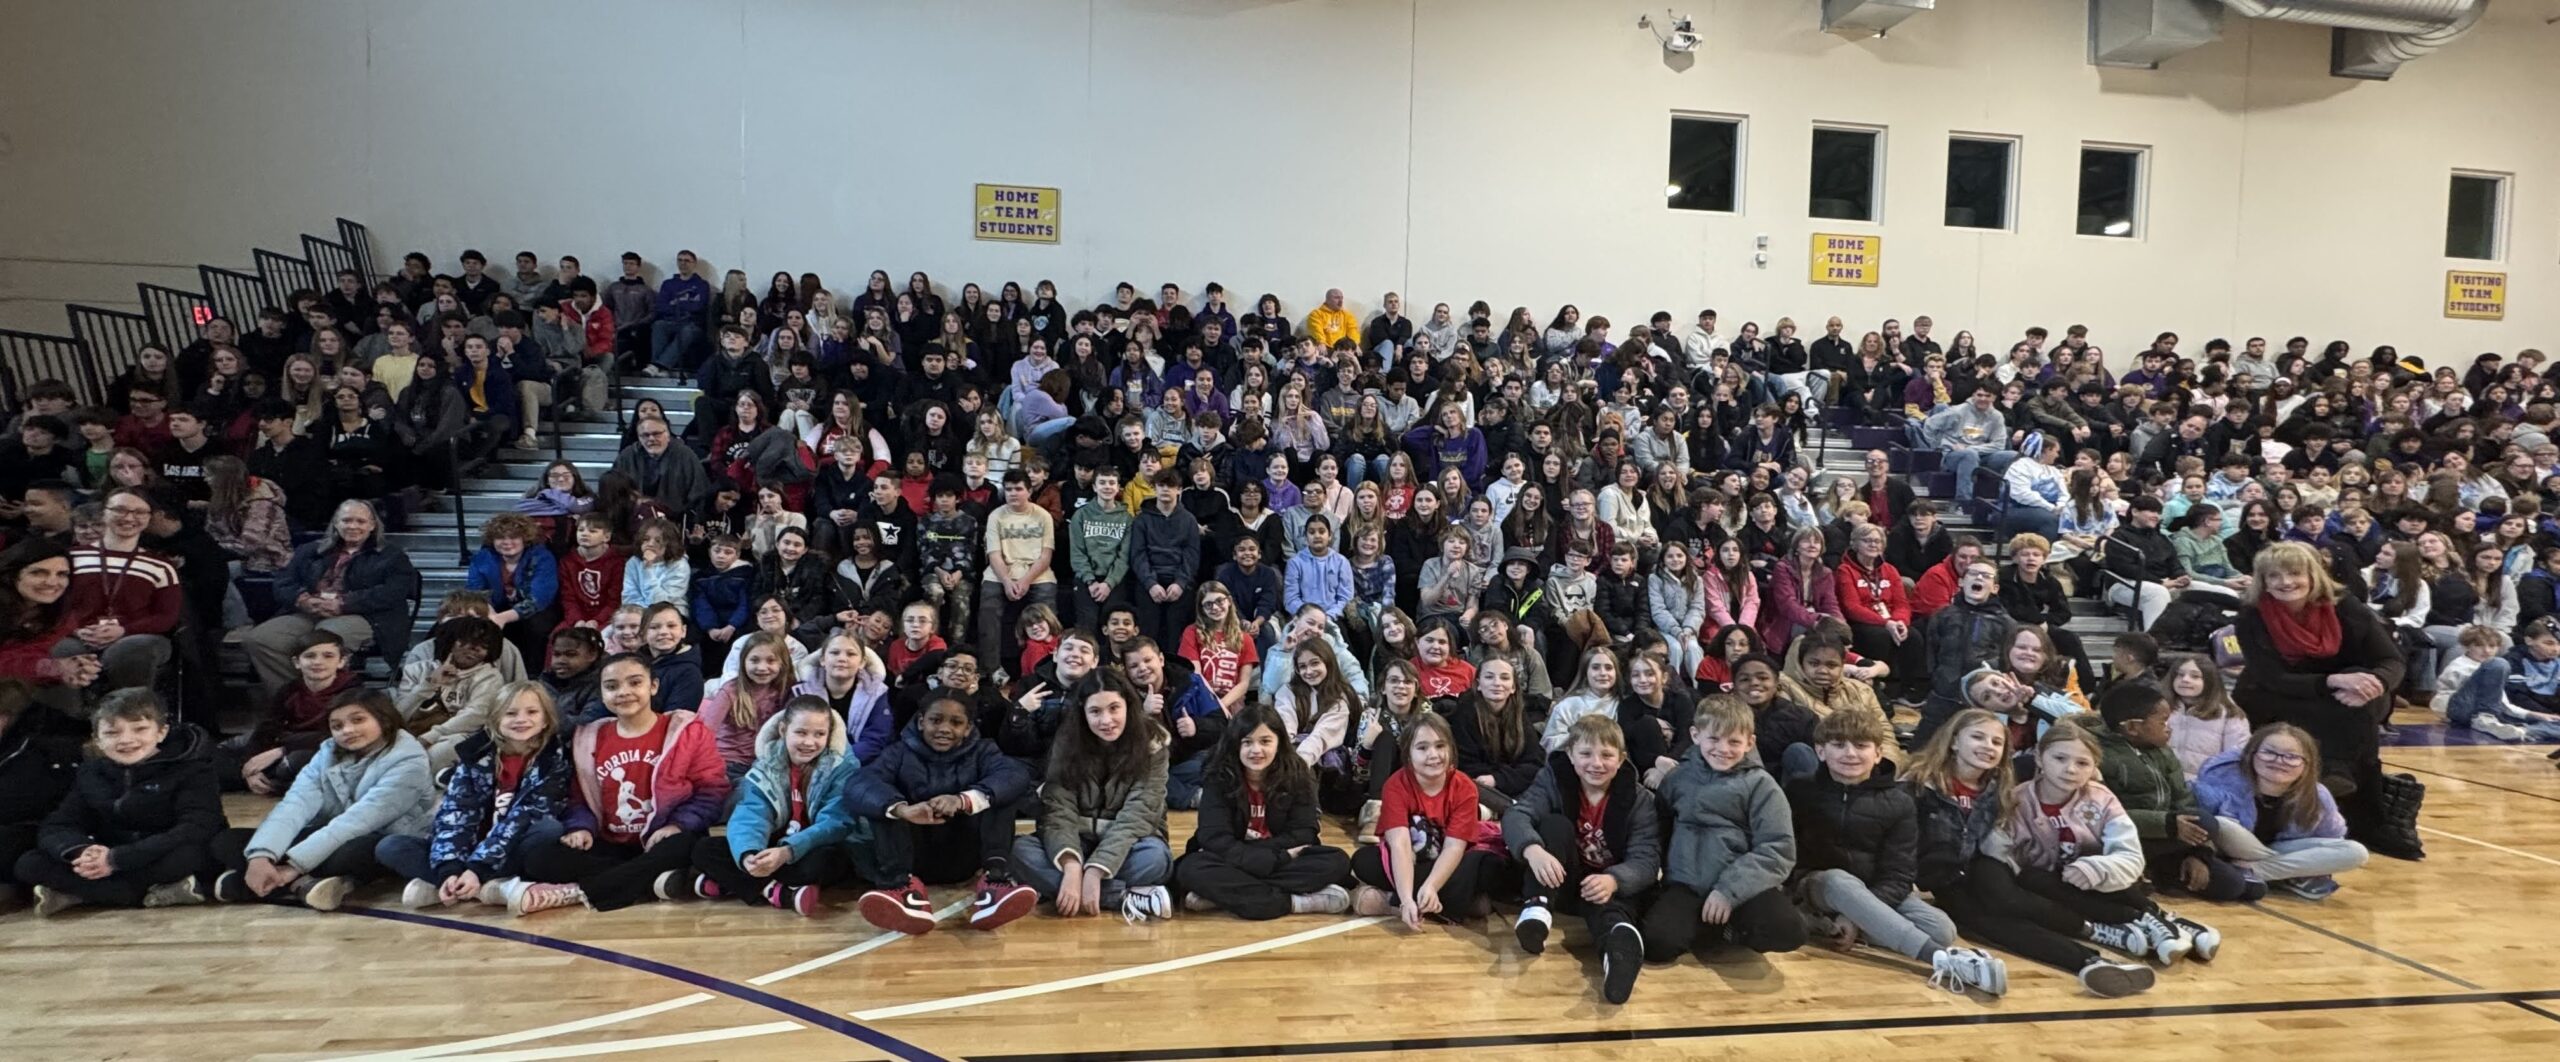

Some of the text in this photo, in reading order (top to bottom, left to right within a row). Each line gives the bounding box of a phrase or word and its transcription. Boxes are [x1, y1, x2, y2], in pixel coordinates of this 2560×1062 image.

[994, 190, 1039, 203] HOME
[994, 206, 1039, 219] TEAM
[980, 222, 1053, 236] STUDENTS
[1828, 239, 1864, 250] HOME
[1828, 253, 1864, 264] TEAM
[1828, 267, 1862, 279] FANS
[2453, 275, 2502, 286] VISITING
[2462, 288, 2493, 299] TEAM
[2450, 301, 2501, 313] STUDENTS
[596, 748, 641, 780] CORDIA
